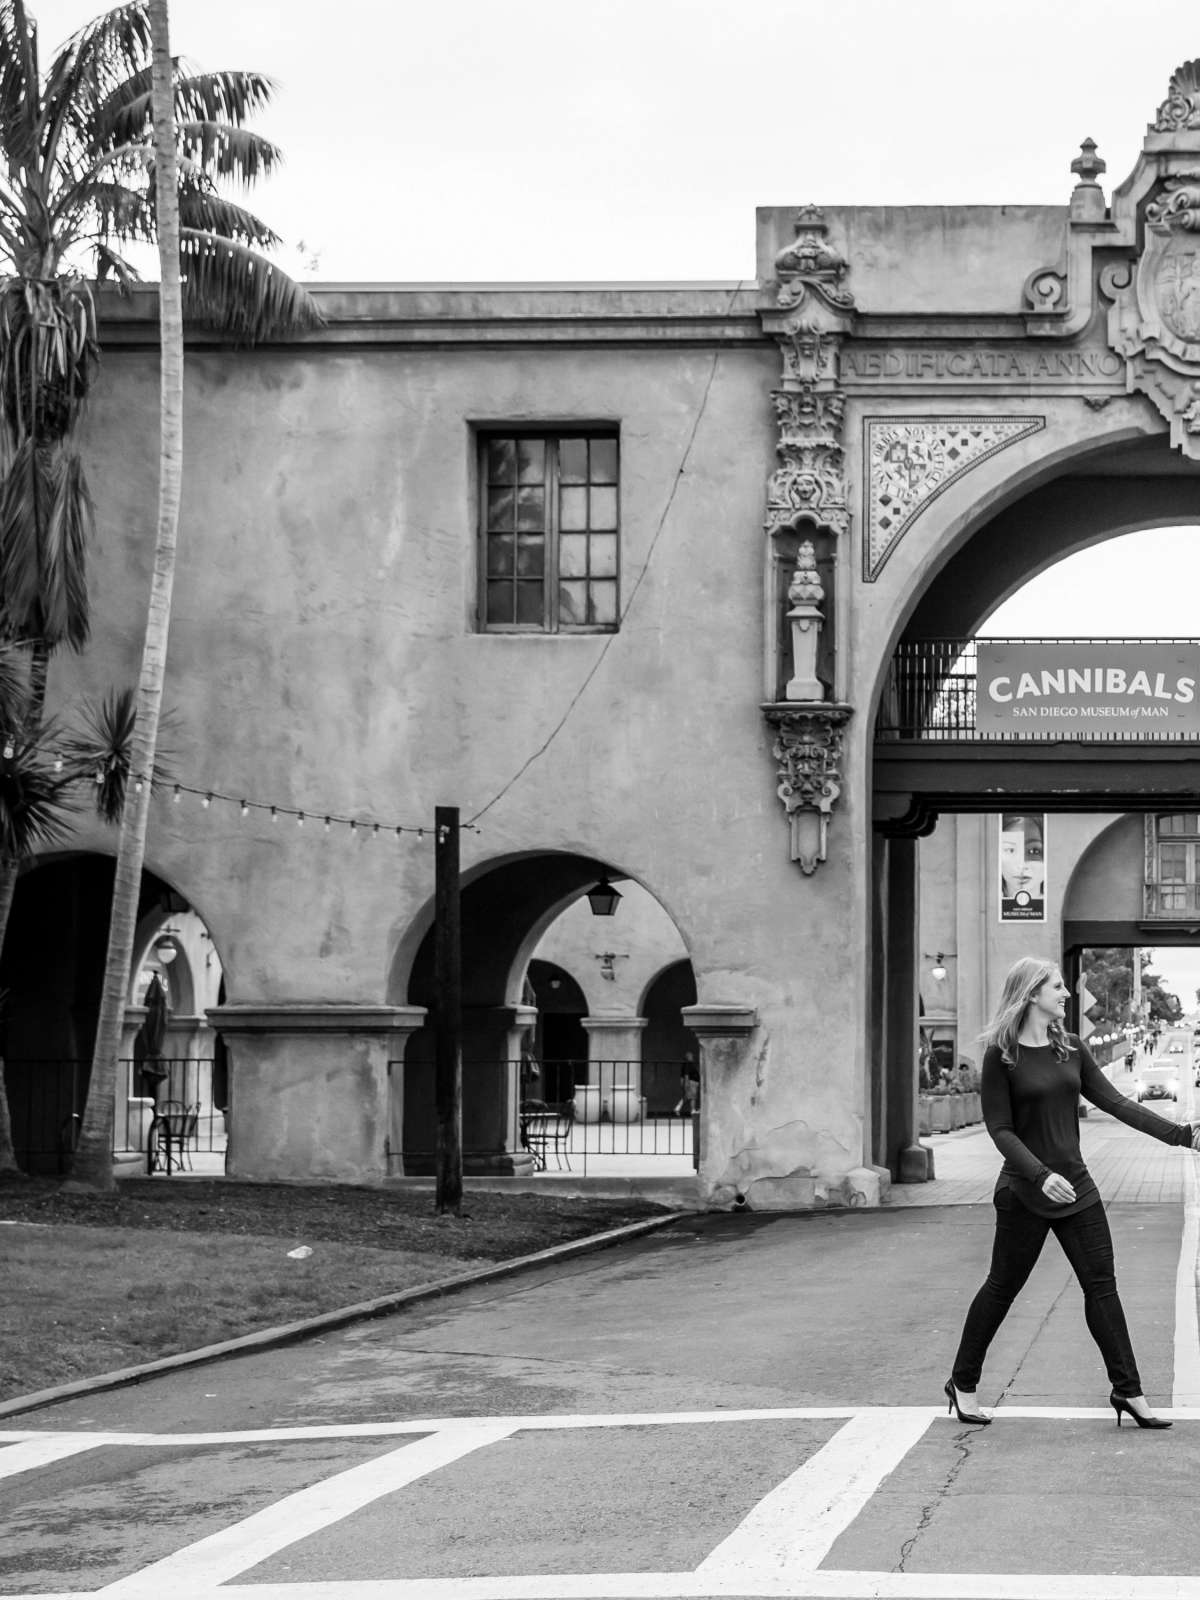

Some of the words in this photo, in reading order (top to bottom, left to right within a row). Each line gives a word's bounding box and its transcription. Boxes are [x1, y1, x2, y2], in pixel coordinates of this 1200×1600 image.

[840, 352, 1027, 377] AEDIFICATA
[1032, 352, 1122, 377] ANNO
[988, 668, 1196, 703] CANNIBALS
[1012, 706, 1037, 717] SAN
[1040, 706, 1079, 717] DIEGO
[1080, 706, 1129, 717] MUSEUM
[1141, 706, 1169, 717] MAN
